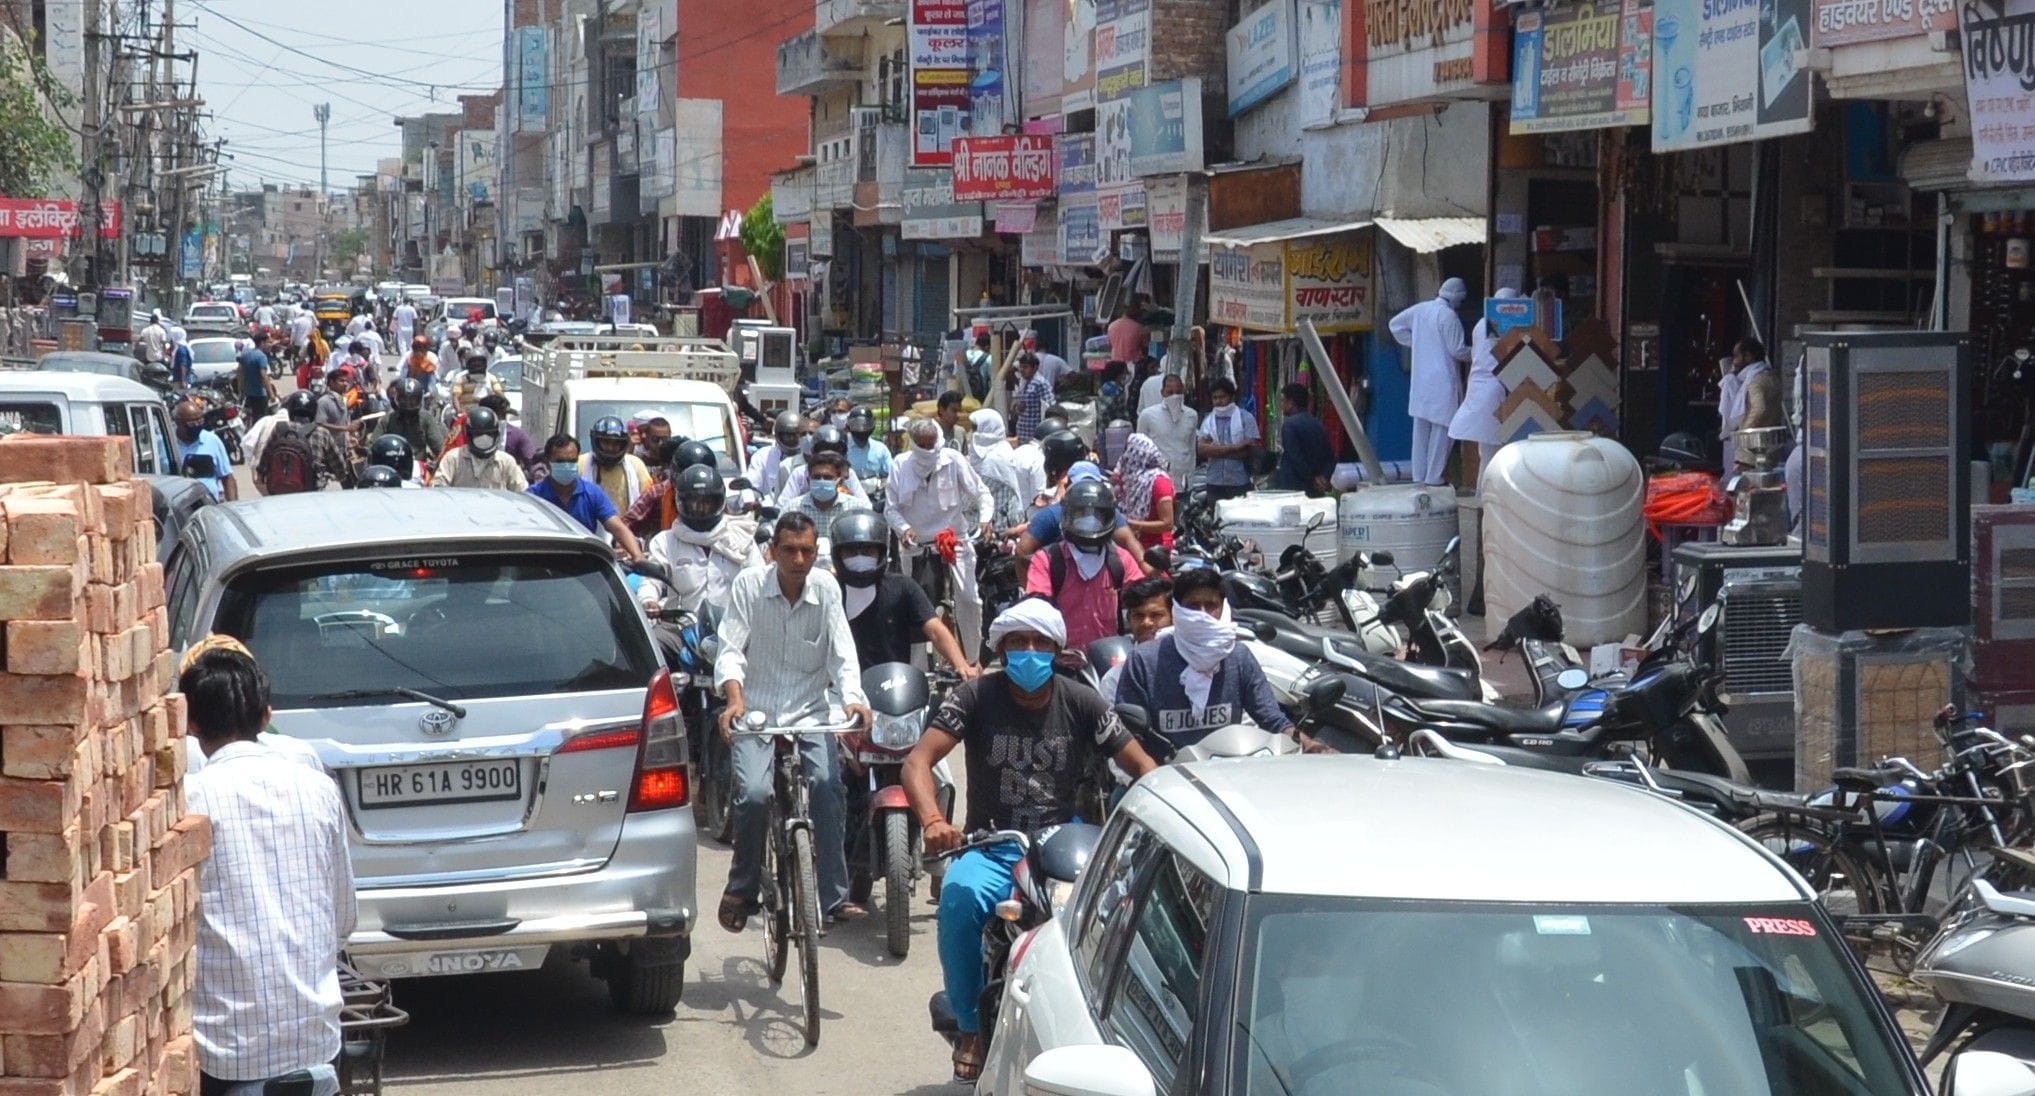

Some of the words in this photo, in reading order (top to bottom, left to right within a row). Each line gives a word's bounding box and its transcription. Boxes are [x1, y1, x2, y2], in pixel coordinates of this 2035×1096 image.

[928, 38, 966, 52] कूलर
[1543, 3, 1619, 60] डालमिया
[954, 140, 970, 181] श्री
[972, 150, 1009, 181] नानक
[387, 560, 420, 569] GRACE
[423, 558, 459, 567] TOYOTA
[987, 735, 1073, 771] JUST
[376, 774, 402, 797] HR
[412, 769, 452, 794] 61A
[461, 765, 516, 791] 9900
[1744, 917, 1817, 937] PRESS
[412, 952, 524, 974] INNOVA
